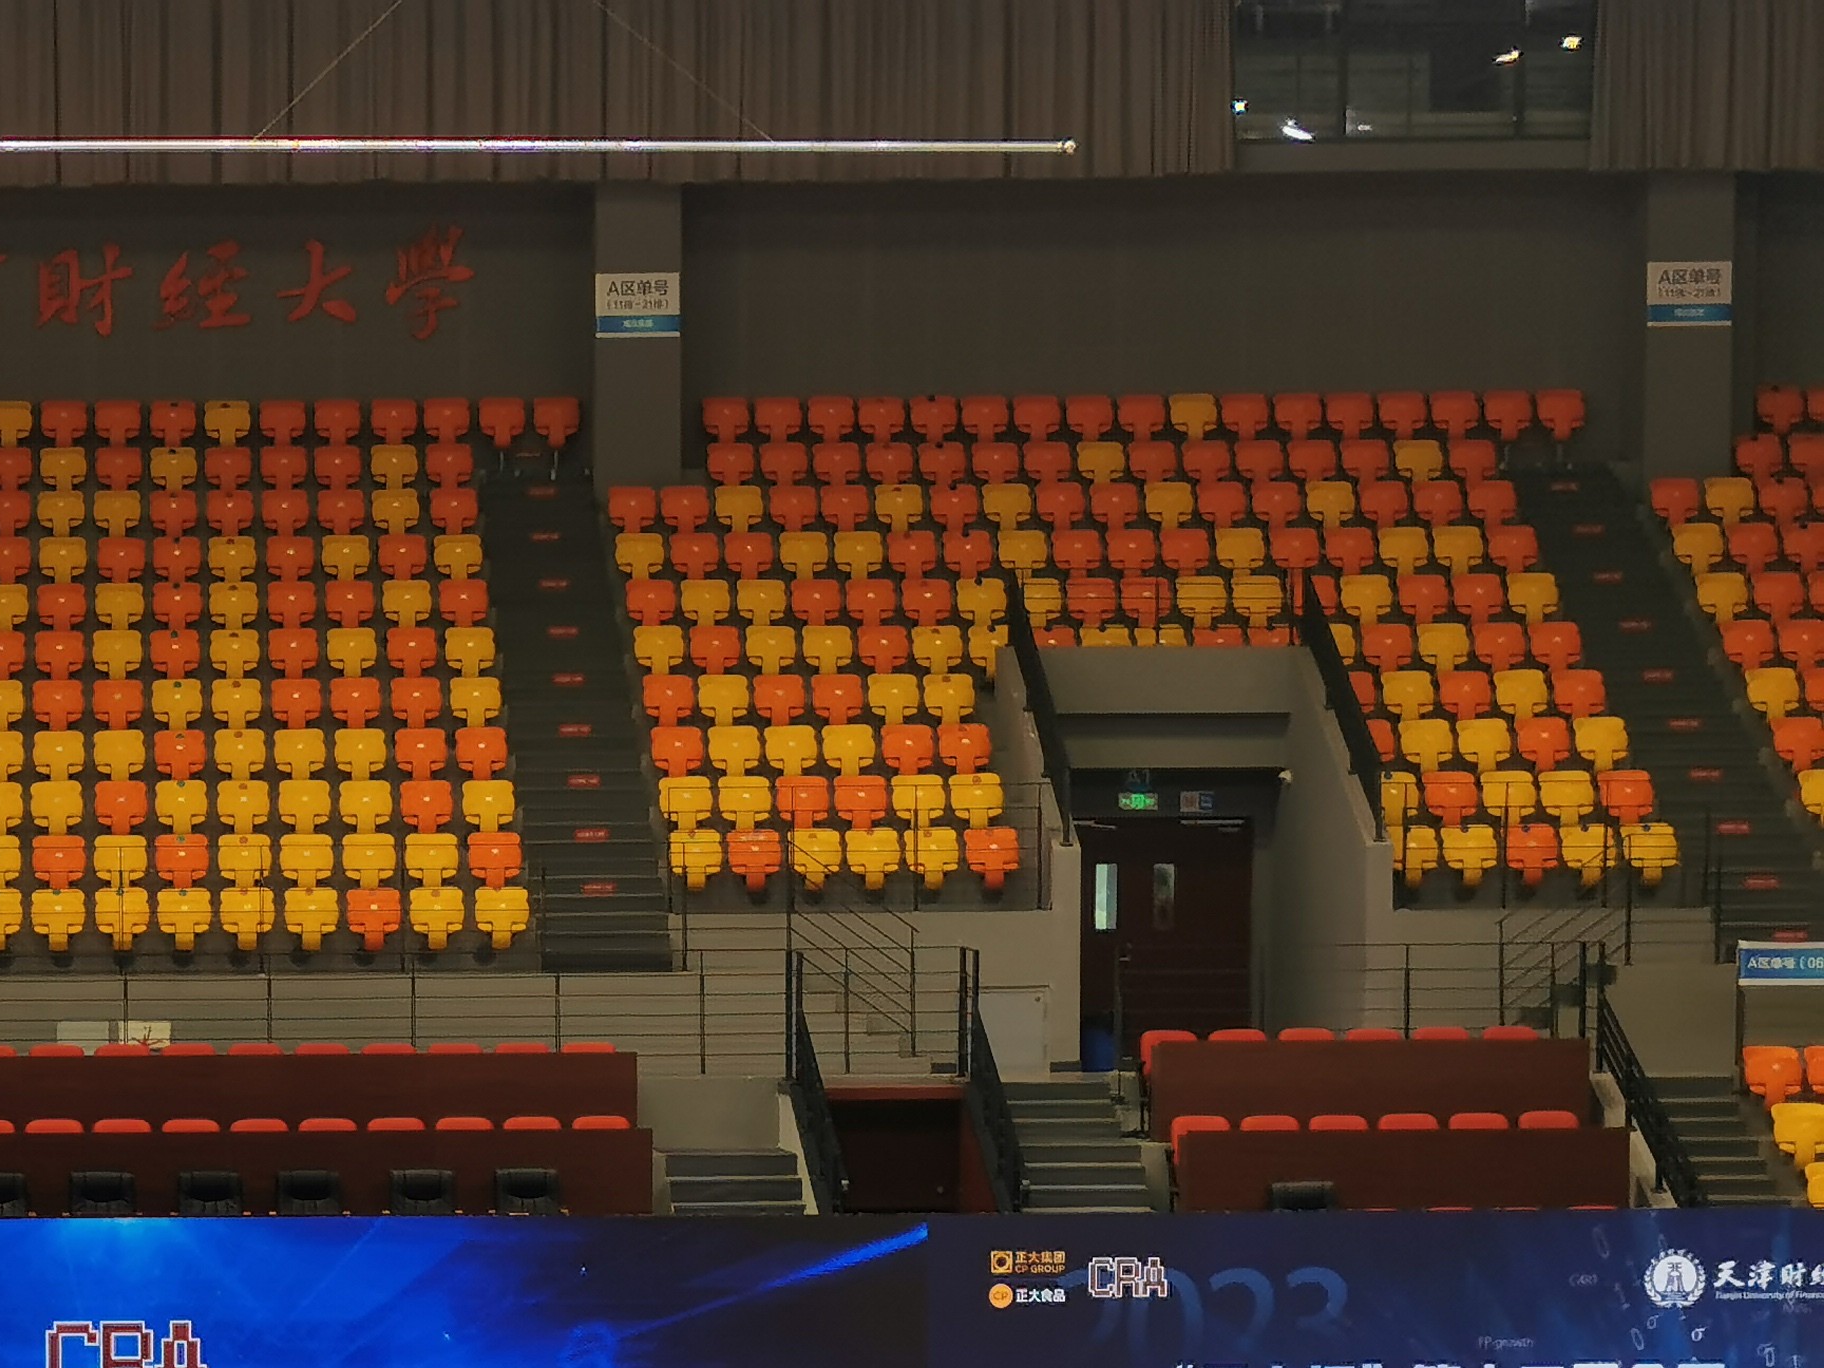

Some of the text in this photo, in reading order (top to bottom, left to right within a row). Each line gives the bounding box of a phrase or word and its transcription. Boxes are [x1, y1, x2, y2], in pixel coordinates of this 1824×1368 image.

[607, 279, 669, 296] A区单号
[1015, 1251, 1066, 1264] 正大集团
[1030, 1264, 1066, 1274] GROUP
[1088, 1256, 1168, 1298] CRA
[1015, 1288, 1066, 1303] 正大食品
